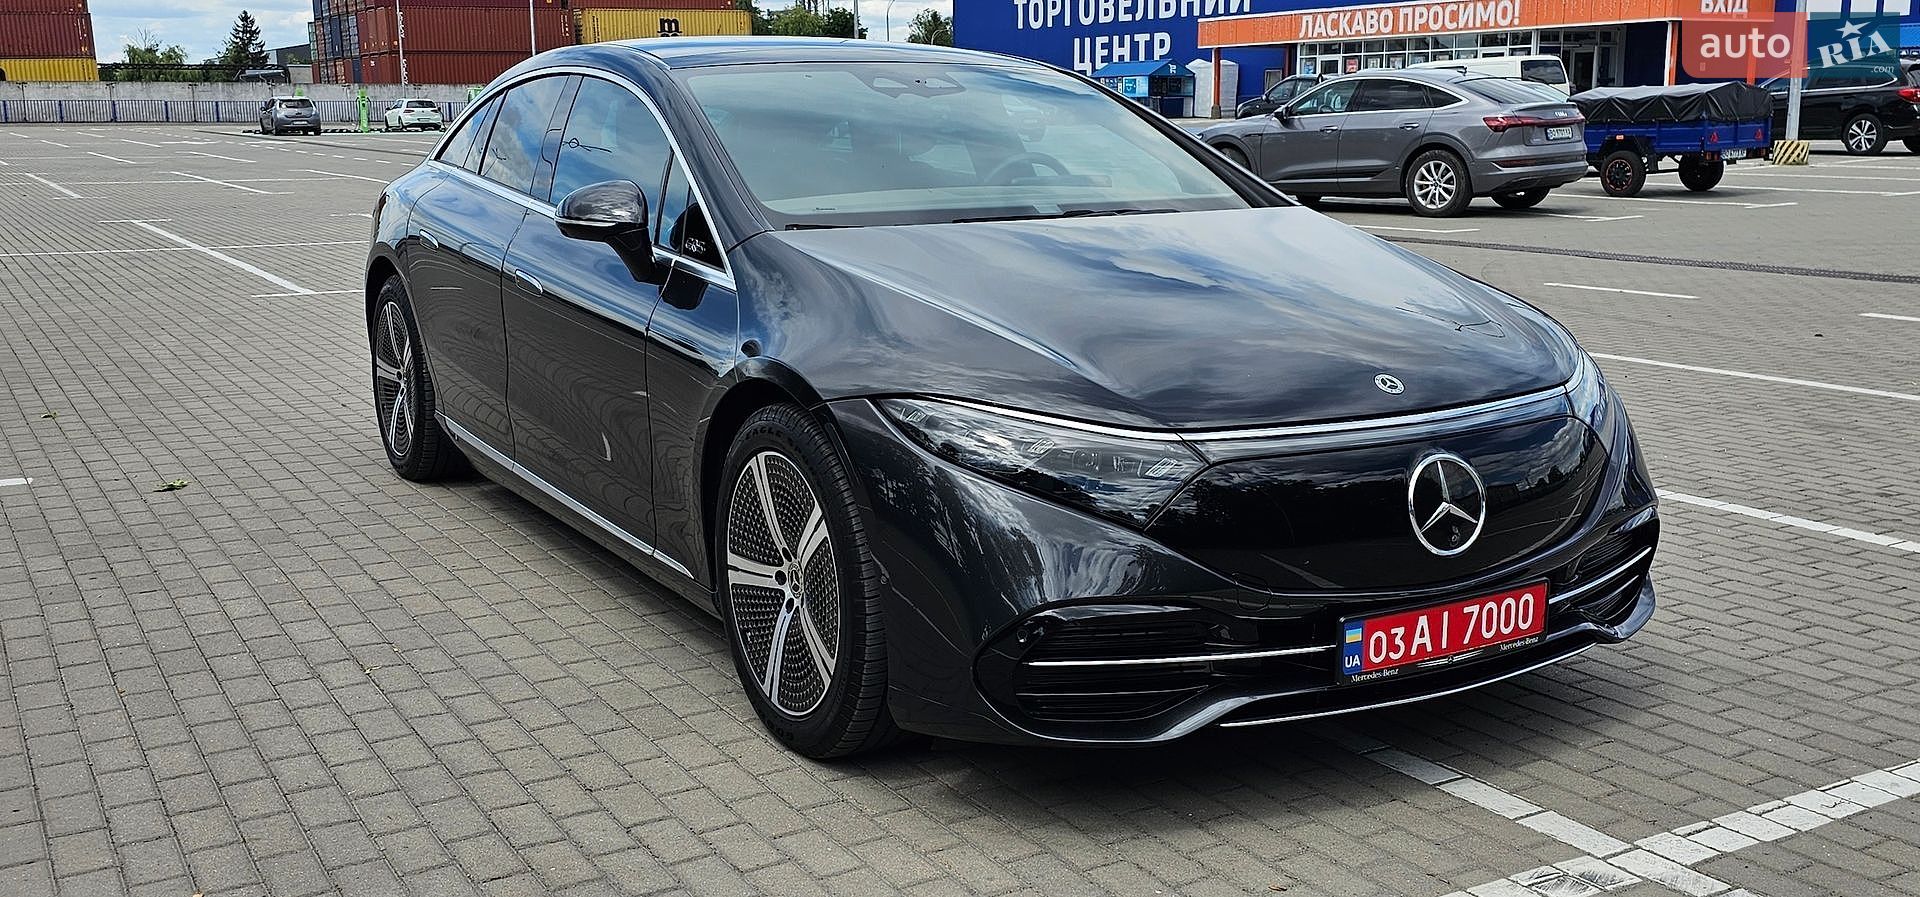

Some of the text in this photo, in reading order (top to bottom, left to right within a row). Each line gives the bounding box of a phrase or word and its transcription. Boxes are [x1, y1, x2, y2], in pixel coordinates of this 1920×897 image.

[1300, 0, 1521, 38] ЛАСКАВО ПРОСИМО!
[1073, 32, 1171, 76] ЦЕНТР
[1462, 593, 1535, 645] 7000
[1344, 653, 1361, 668] UA
